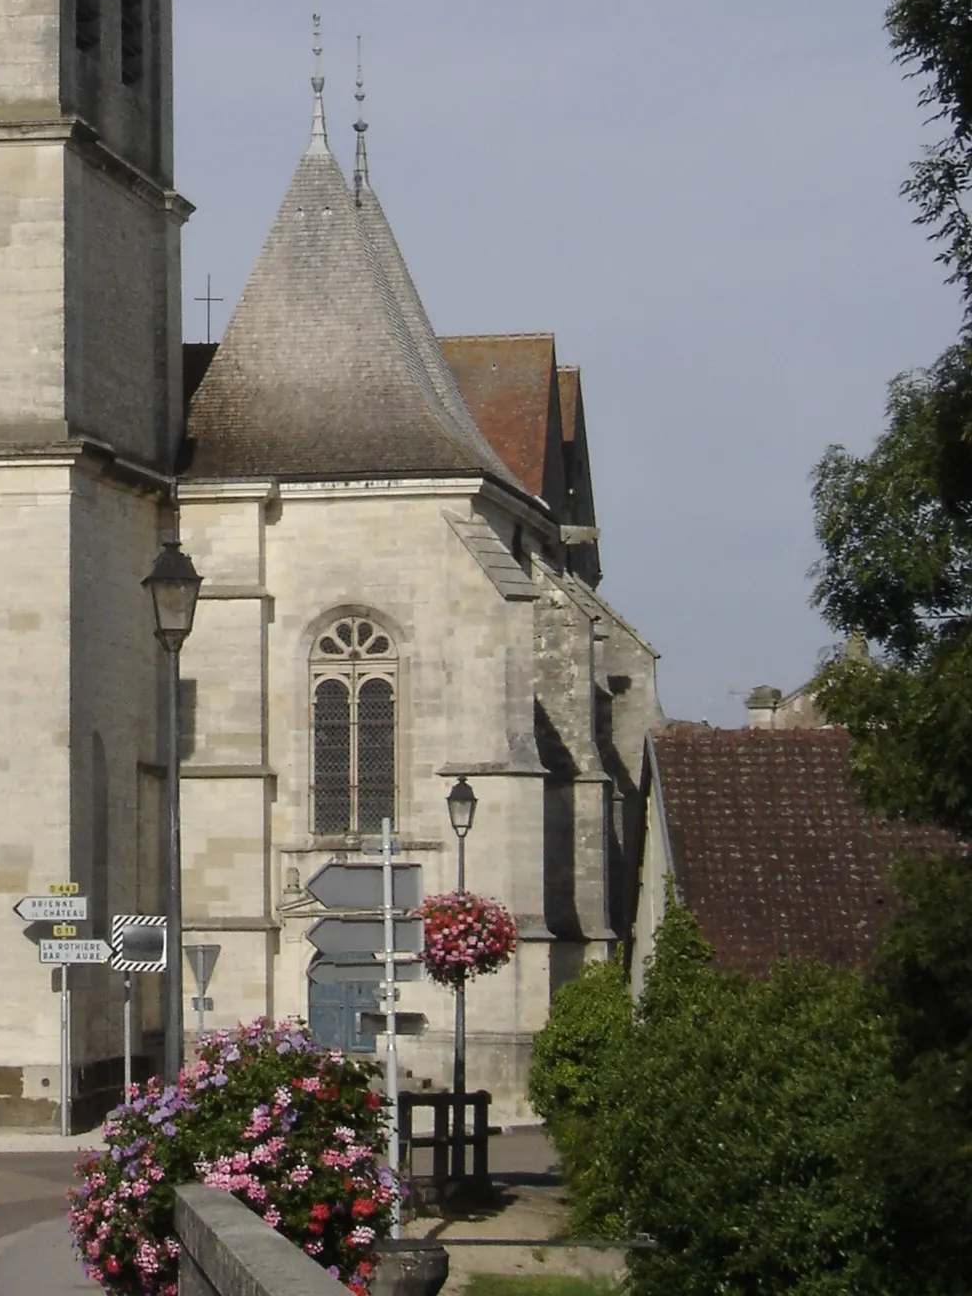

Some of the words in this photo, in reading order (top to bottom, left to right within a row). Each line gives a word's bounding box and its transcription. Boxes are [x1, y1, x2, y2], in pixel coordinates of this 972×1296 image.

[50, 885, 56, 893] D
[31, 900, 73, 908] BRIENNE
[44, 908, 85, 917] CHÂTEAU
[56, 927, 62, 935] D
[42, 943, 53, 951] LA
[58, 942, 101, 951] ROTHIÈRE
[43, 952, 60, 960] BAR
[75, 952, 101, 960] AUBE
